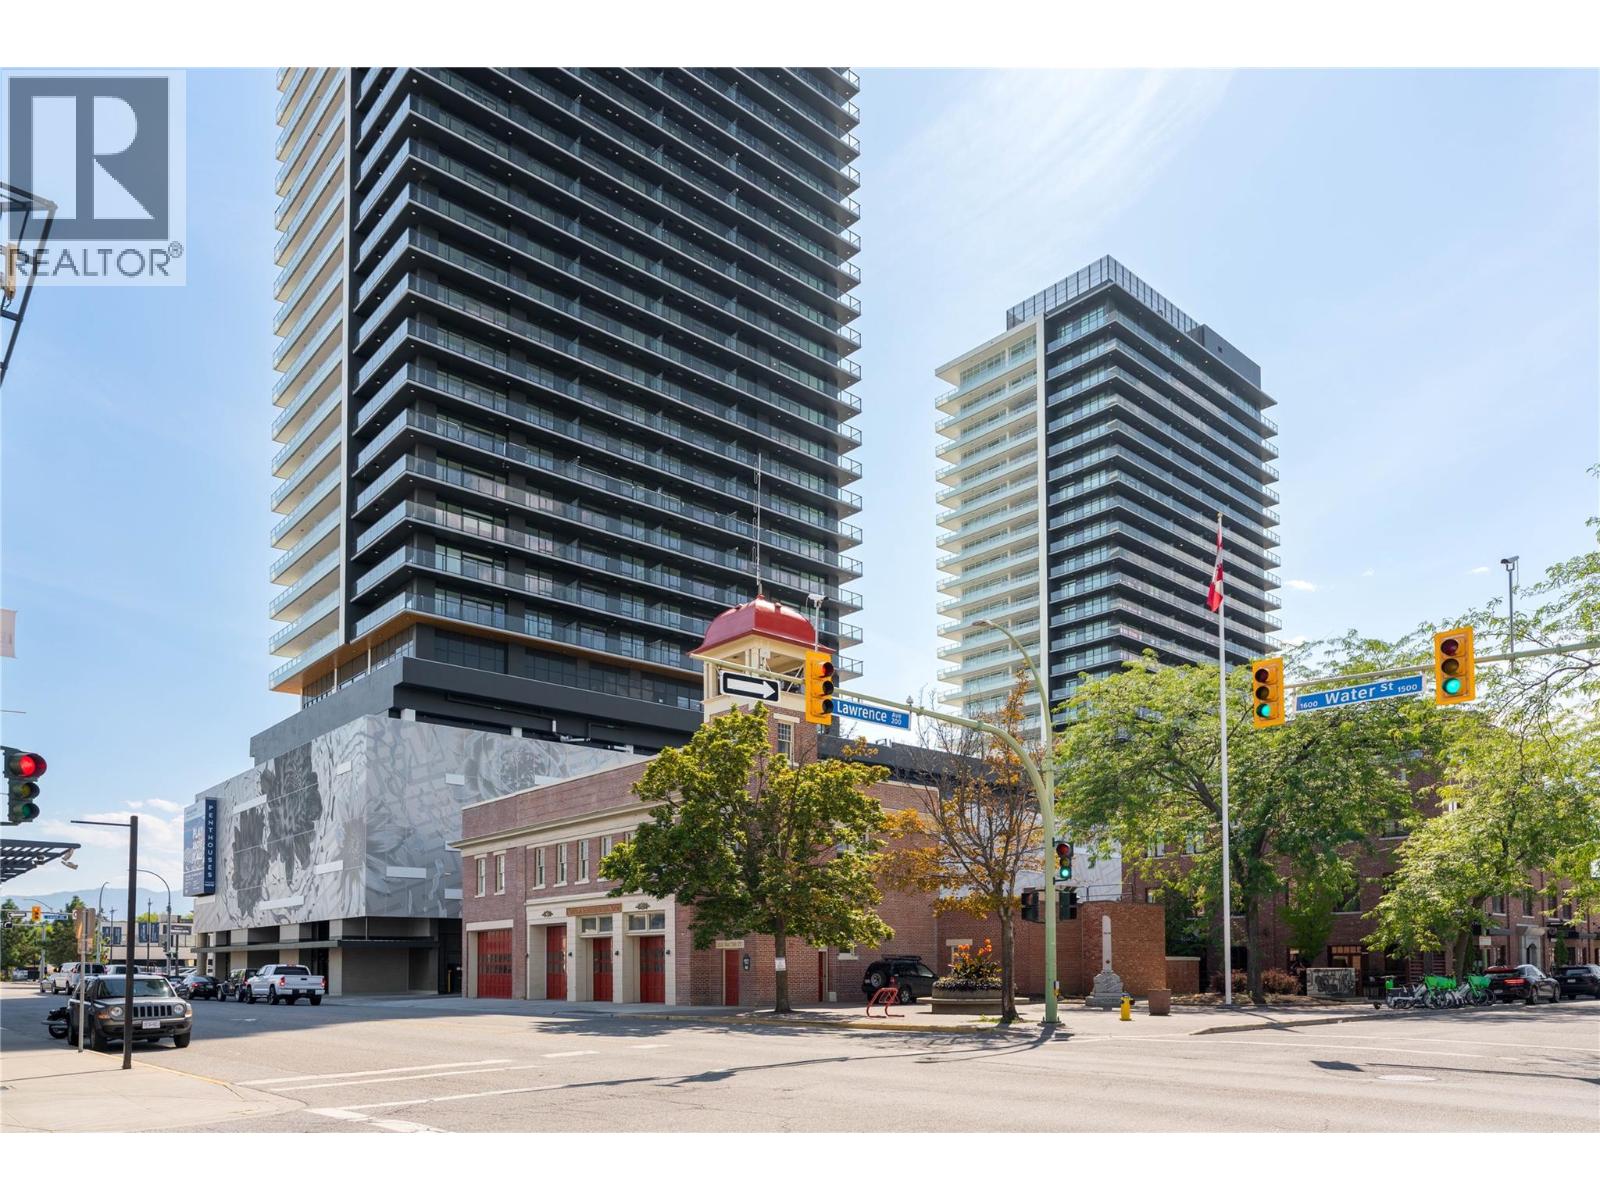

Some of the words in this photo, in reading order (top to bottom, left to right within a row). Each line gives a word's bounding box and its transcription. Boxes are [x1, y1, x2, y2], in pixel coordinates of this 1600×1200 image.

[1300, 701, 1318, 709] 1600
[1325, 686, 1376, 705] Water
[1380, 682, 1394, 692] St
[1397, 683, 1418, 693] 1500
[837, 701, 887, 722] Lawrence
[890, 718, 902, 726] 200
